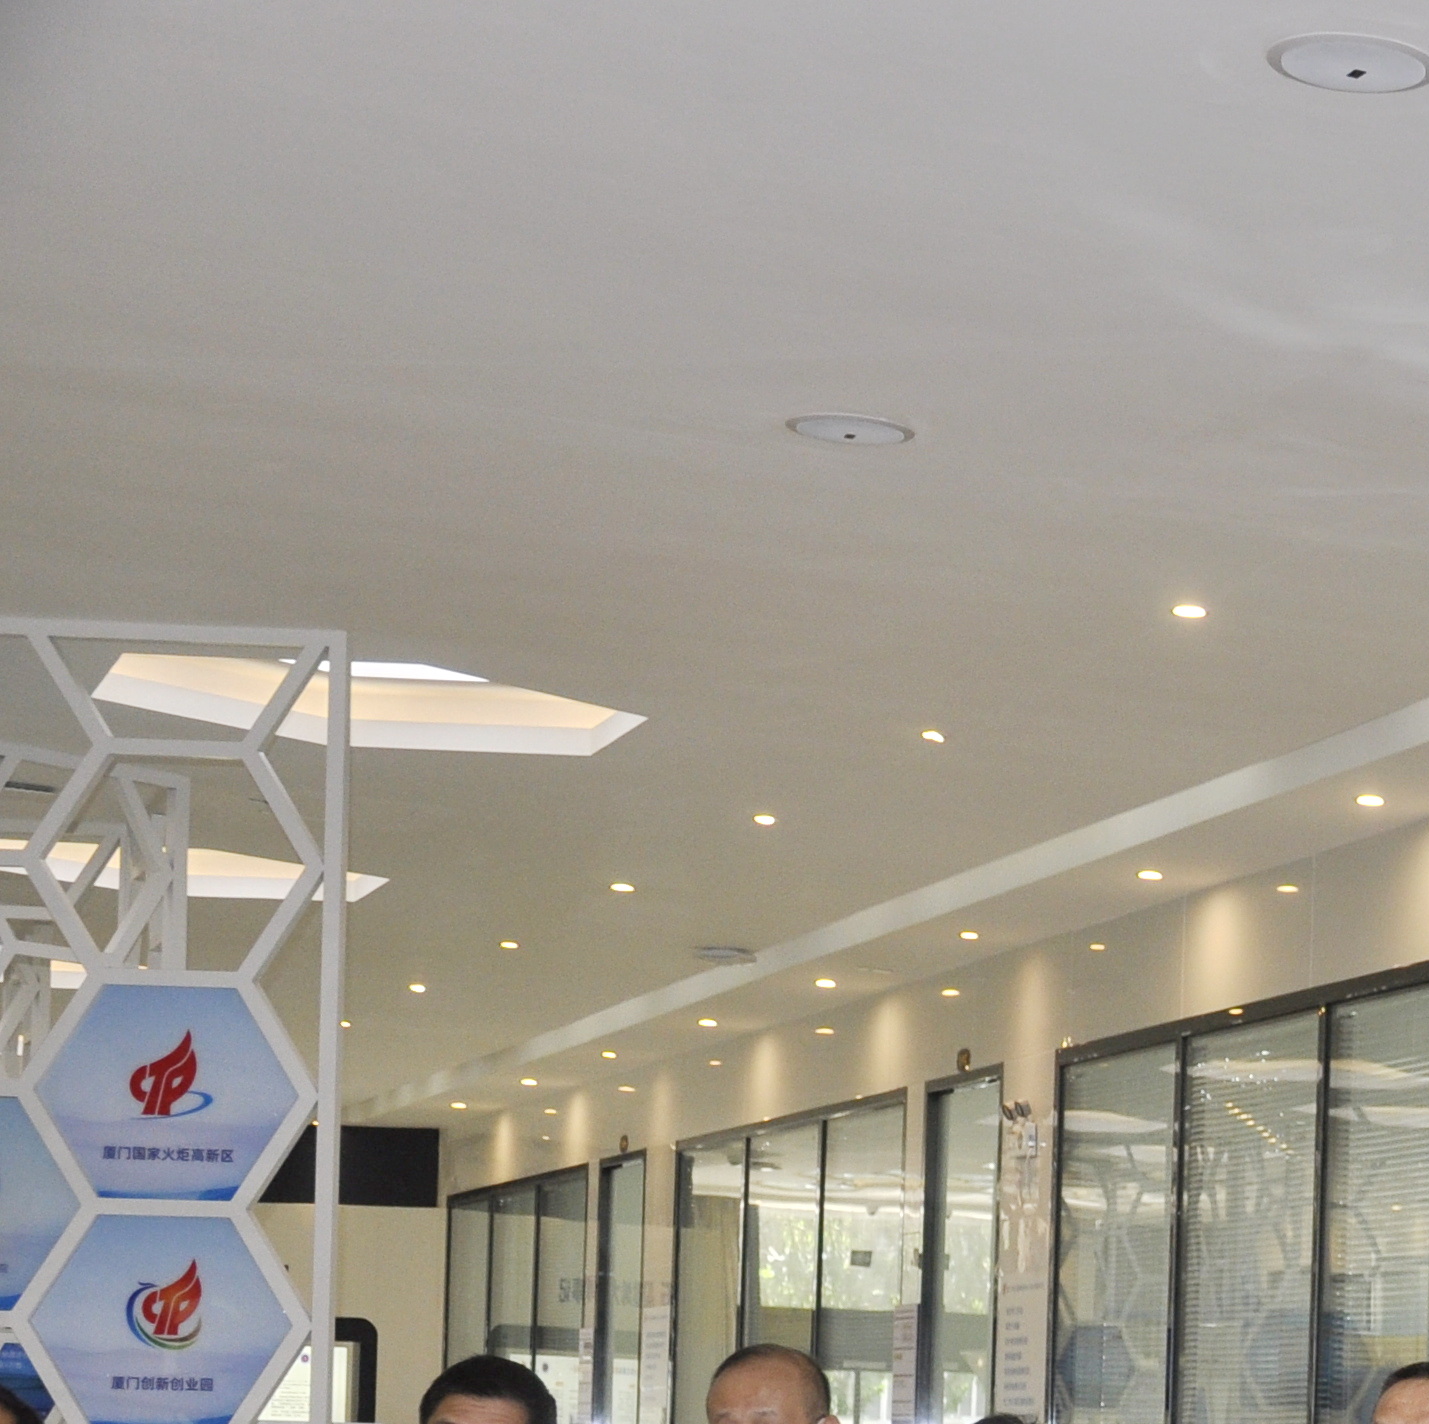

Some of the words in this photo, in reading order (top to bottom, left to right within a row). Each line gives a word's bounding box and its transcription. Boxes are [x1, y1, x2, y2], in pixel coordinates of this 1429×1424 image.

[102, 1145, 235, 1164] 厦门国家火炬高新区
[111, 1375, 214, 1392] 厦门创新创业园
